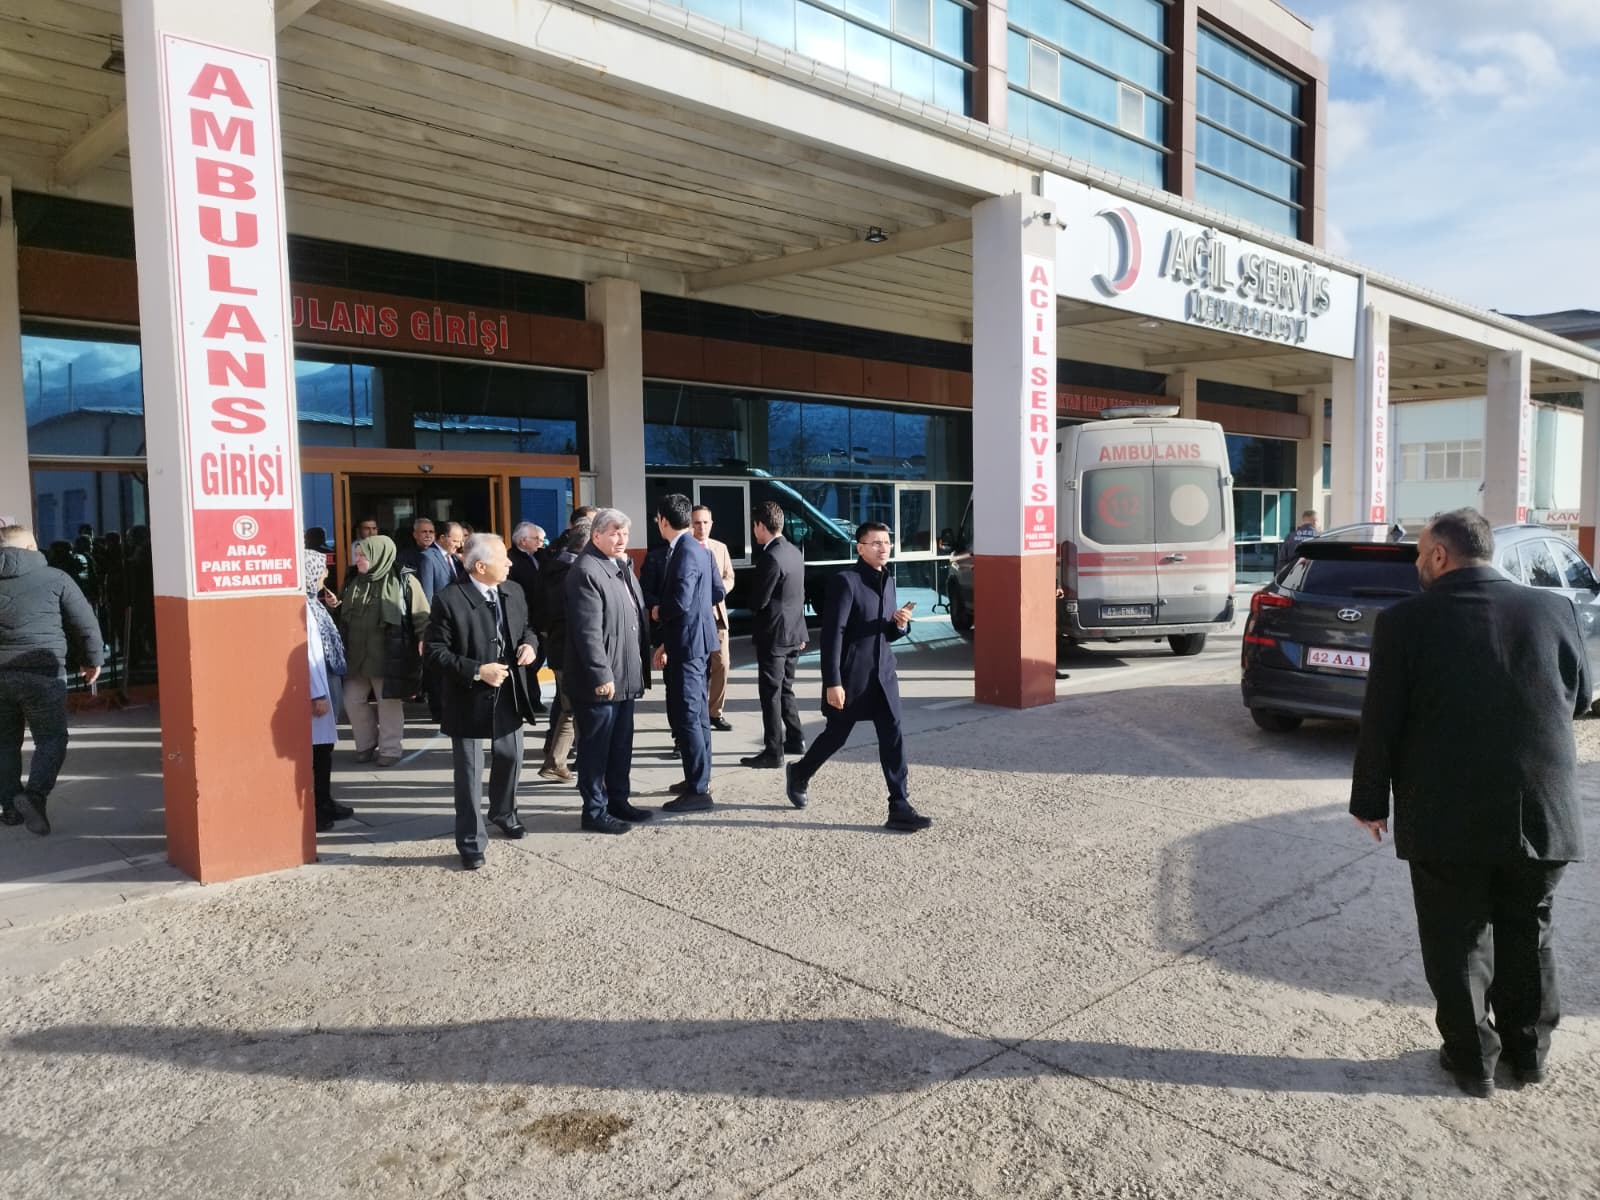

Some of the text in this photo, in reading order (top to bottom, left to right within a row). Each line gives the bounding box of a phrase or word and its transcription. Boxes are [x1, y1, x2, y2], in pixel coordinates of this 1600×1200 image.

[188, 63, 267, 434] AMBULANS
[410, 306, 509, 355] GİRİŞİ
[1099, 443, 1201, 462] AMBULANS
[201, 443, 283, 502] GİRİŞİ
[1546, 511, 1580, 522] KAN
[226, 544, 267, 557] ARAÇ
[201, 558, 293, 573] PARK ETMEK
[212, 573, 283, 588] YASAKTIR
[1312, 652, 1329, 663] 42
[1332, 654, 1355, 666] AA
